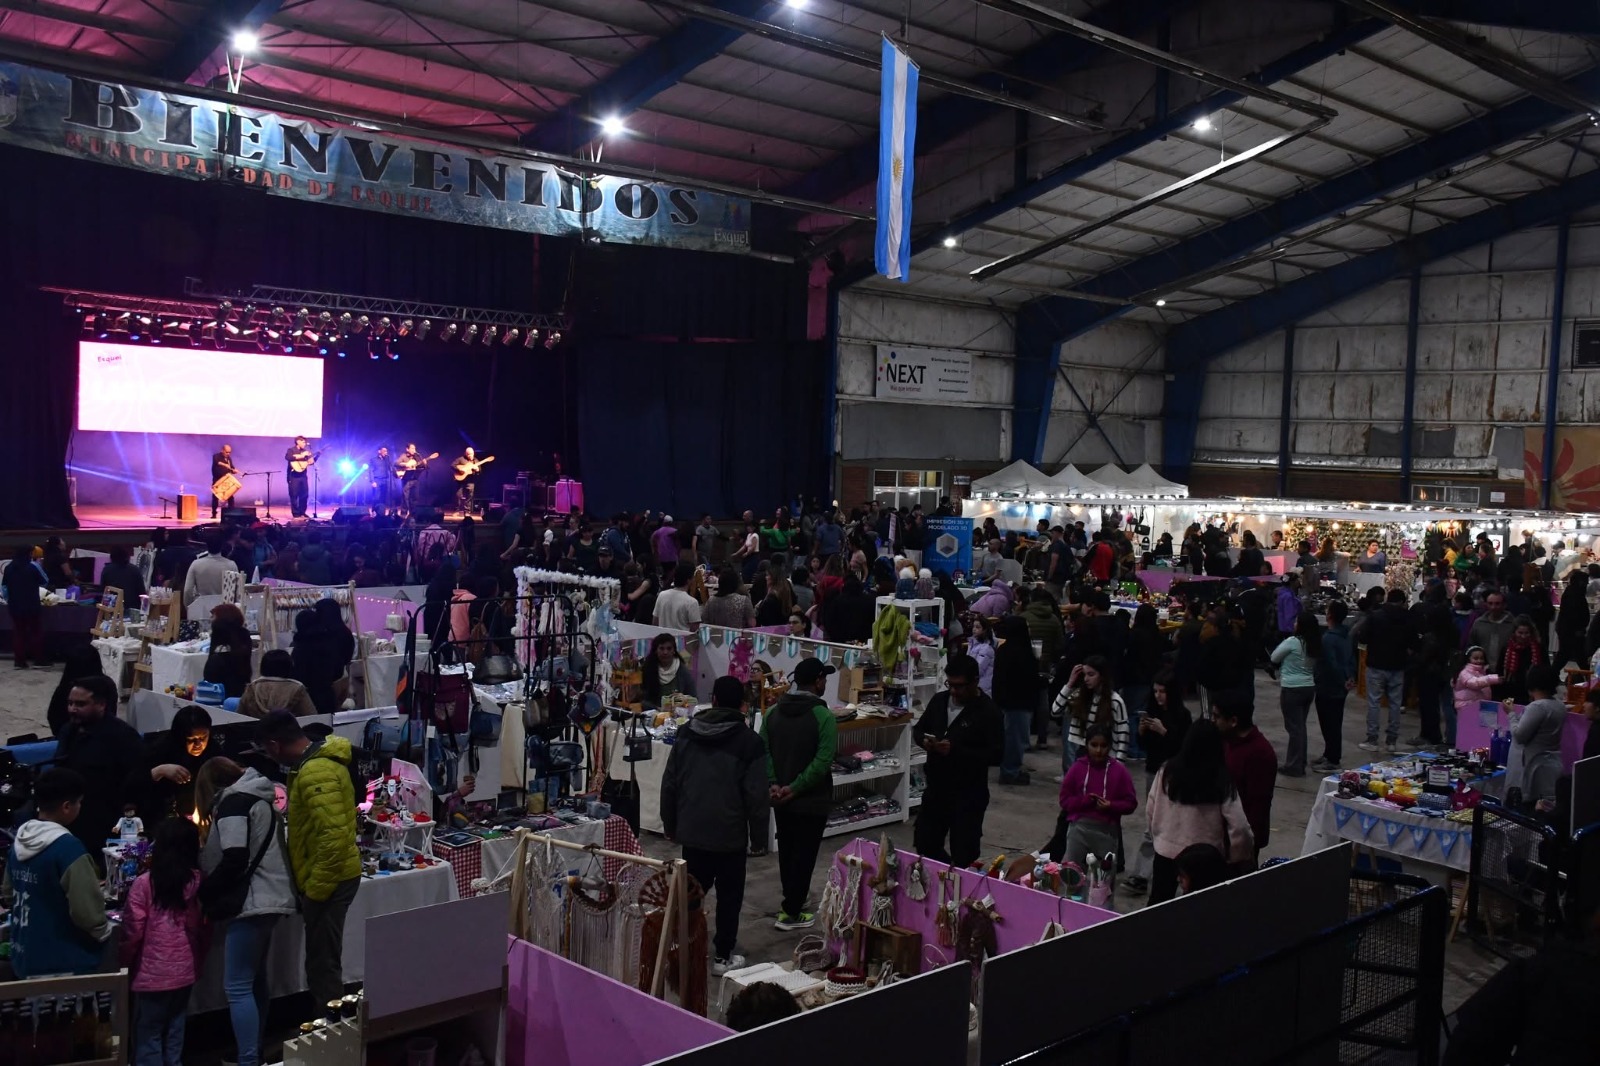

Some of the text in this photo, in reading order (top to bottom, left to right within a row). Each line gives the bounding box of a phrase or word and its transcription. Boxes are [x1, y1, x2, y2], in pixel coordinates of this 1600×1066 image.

[64, 75, 699, 226] BIENVENIDOS
[64, 131, 293, 190] MUNICIPADAD
[714, 228, 749, 246] Esquel
[886, 363, 926, 384] NEXT
